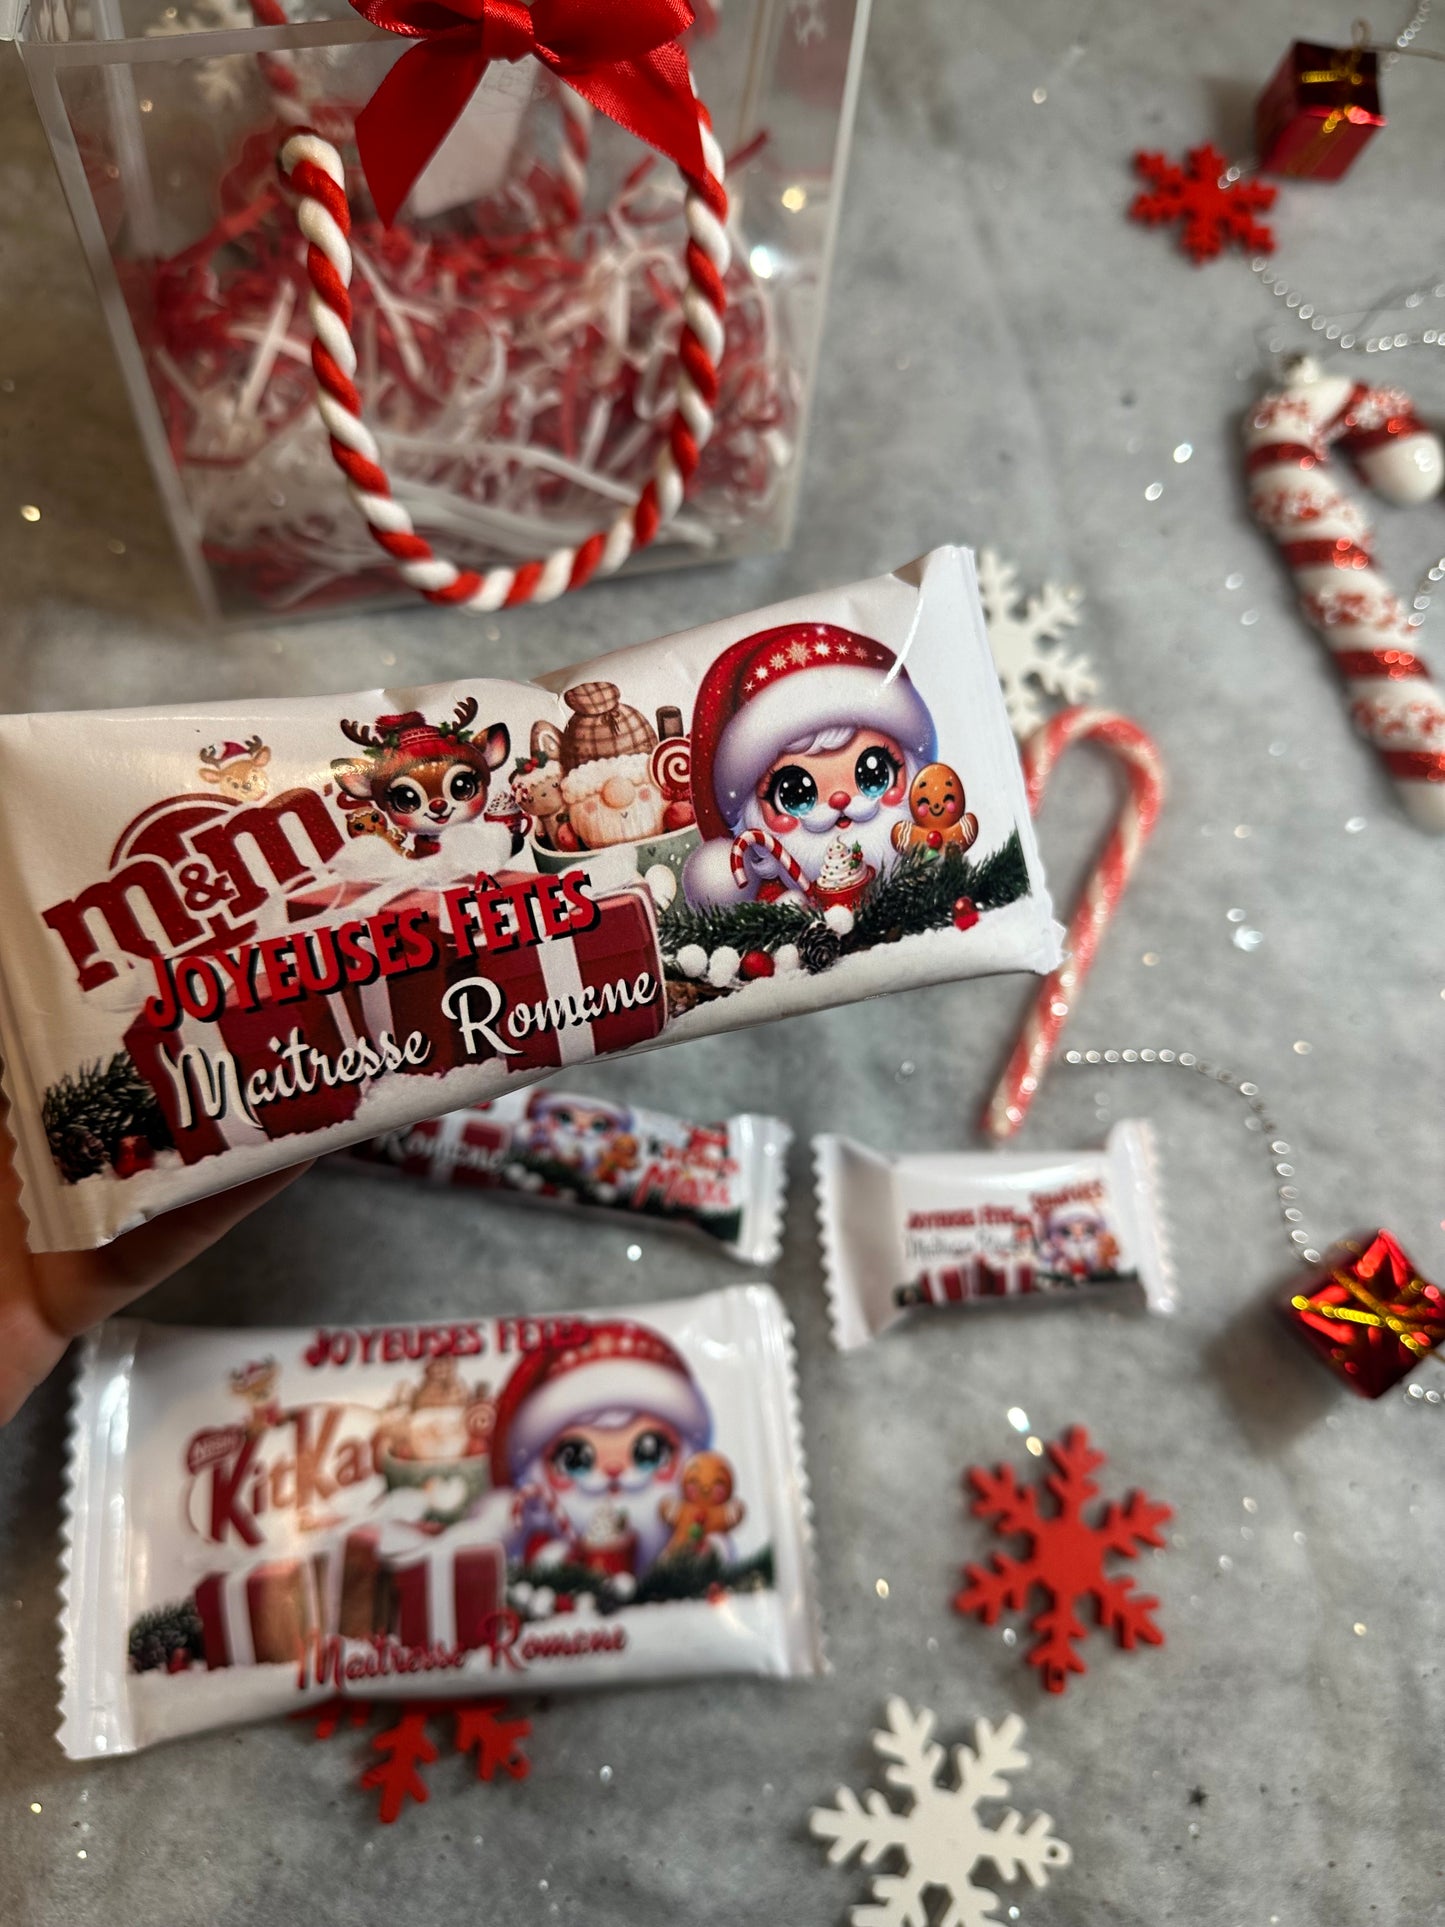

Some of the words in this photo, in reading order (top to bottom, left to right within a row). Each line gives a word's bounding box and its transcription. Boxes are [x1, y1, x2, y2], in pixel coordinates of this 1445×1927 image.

[146, 907, 440, 1029] JOYEUSES
[442, 869, 602, 960] FÊTES
[159, 1025, 432, 1131] Maitresse
[441, 970, 658, 1056] Romane
[304, 1323, 483, 1367] JOYEUSES
[475, 1607, 628, 1672] Romane
